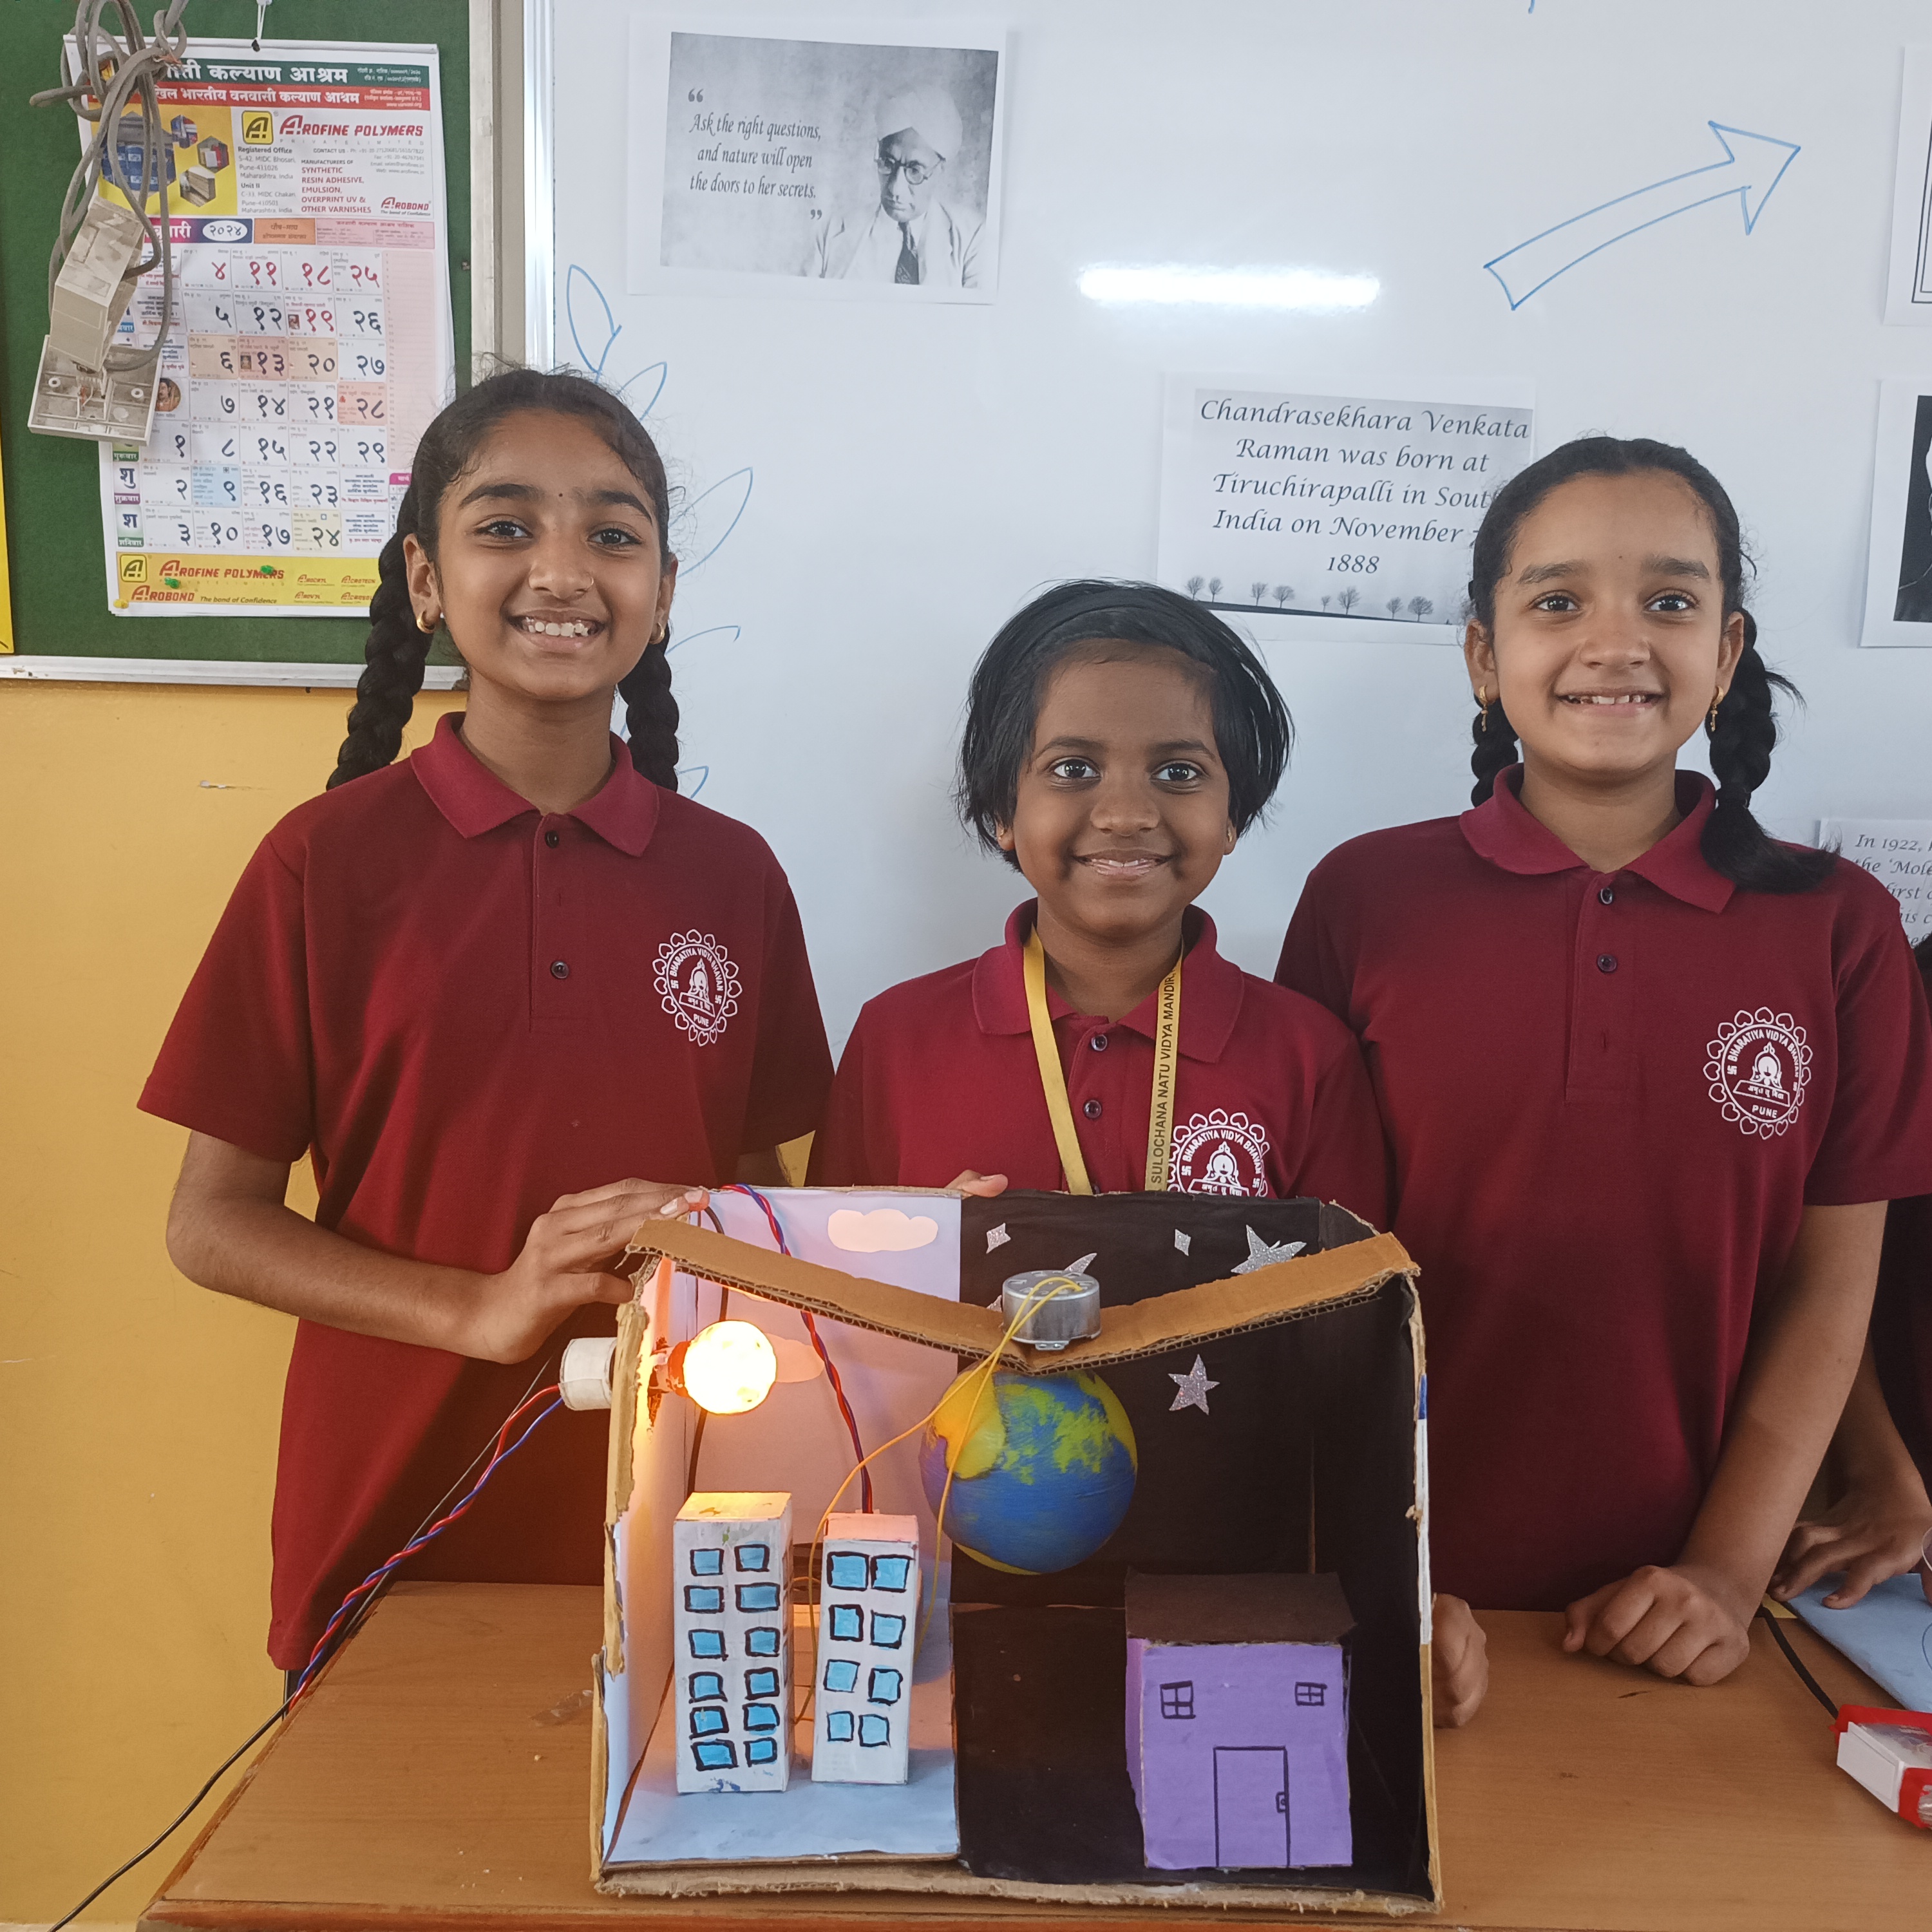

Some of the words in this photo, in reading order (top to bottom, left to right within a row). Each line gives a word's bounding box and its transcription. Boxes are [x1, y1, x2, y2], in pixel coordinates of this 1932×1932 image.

[207, 65, 281, 82] कल्याण
[290, 67, 348, 83] आश्रम
[155, 84, 178, 100] खिल
[180, 86, 227, 101] भारतीय
[230, 88, 276, 102] वनवासी
[279, 91, 321, 103] कल्याण
[325, 92, 359, 104] आश्रम
[354, 125, 423, 137] POLYMERS
[689, 112, 715, 137] Ask
[717, 113, 734, 133] the
[737, 115, 764, 140] right
[767, 120, 821, 142] questions,
[698, 142, 722, 162] and
[723, 149, 759, 164] nature
[762, 146, 787, 166] will
[786, 154, 813, 173] open
[690, 171, 708, 191] the
[711, 173, 741, 193] doors
[743, 179, 755, 194] to
[758, 176, 777, 195] her
[778, 183, 816, 198] secrets.
[210, 225, 242, 237] २०२४
[211, 261, 226, 280] ४
[249, 261, 277, 286] ११
[301, 262, 330, 287] १८
[350, 265, 380, 288] २५
[215, 305, 232, 328] ५
[254, 307, 281, 330] १२
[305, 308, 334, 332] १९
[353, 310, 382, 335] २६
[220, 352, 234, 374] ६
[257, 352, 284, 376] १३
[308, 354, 336, 375] २०
[356, 355, 384, 376] २७
[221, 395, 235, 413] ७
[258, 395, 285, 417] १४
[308, 397, 334, 420] २१
[356, 398, 384, 419] २८
[1201, 398, 1412, 431] Chandrasekhara
[1421, 410, 1529, 439] Venkata
[175, 435, 185, 458] १
[222, 439, 235, 457] ८
[258, 438, 287, 460] १५
[309, 440, 337, 462] २२
[357, 442, 385, 463] २९
[1236, 439, 1330, 462] Raman
[1338, 450, 1387, 466] was
[1396, 445, 1455, 471] born
[1463, 453, 1490, 473] at
[119, 468, 137, 489] शु
[175, 479, 187, 500] २
[1213, 471, 1393, 507] Tiruchirapalli
[1402, 484, 1426, 505] in
[1434, 487, 1490, 509] Sout
[223, 480, 236, 502] ९
[260, 481, 287, 505] १६
[310, 484, 338, 507] २३
[122, 514, 138, 529] श
[1213, 509, 1282, 532] India
[1291, 520, 1321, 535] on
[1329, 516, 1464, 542] November
[178, 524, 191, 546] ३
[211, 522, 238, 545] १०
[262, 524, 290, 547] १७
[312, 527, 340, 547] २४
[1327, 554, 1379, 574] 1888
[1855, 835, 1875, 848] In
[1882, 838, 1922, 852] 1922,
[670, 947, 697, 977] BHARATIYA
[697, 947, 712, 963] VIDYA
[711, 961, 723, 992] BHAVAN
[693, 1014, 709, 1028] PUNE
[1160, 1023, 1173, 1059] VIDYA
[1727, 1028, 1765, 1062] BHARATIYA
[1765, 1029, 1789, 1048] VIDYA
[1786, 1043, 1799, 1077] BHAVAN
[1157, 1064, 1171, 1098] NATU
[1752, 1104, 1777, 1119] PUNE
[1151, 1102, 1168, 1184] SULOCHANA
[1182, 1130, 1220, 1162] BHARATIYA
[1220, 1130, 1244, 1146] VIDYA
[1243, 1141, 1262, 1174] BHAVAN
